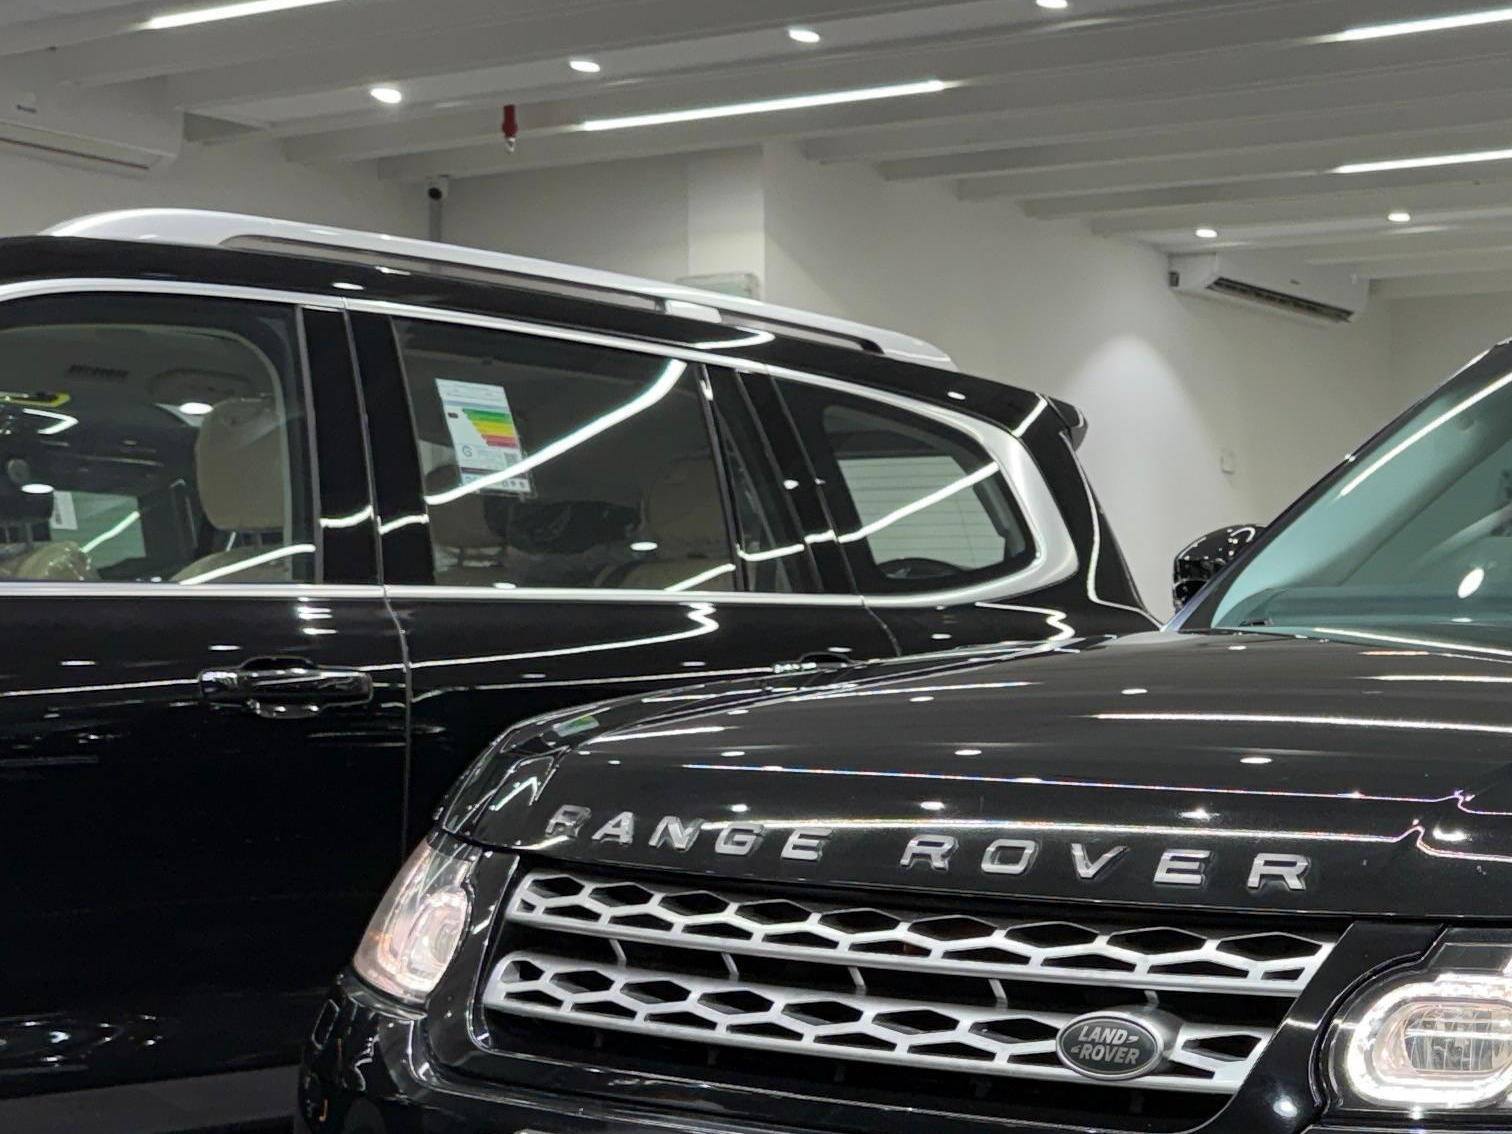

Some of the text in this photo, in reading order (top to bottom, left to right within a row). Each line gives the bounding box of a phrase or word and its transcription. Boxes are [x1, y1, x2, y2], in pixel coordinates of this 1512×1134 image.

[545, 804, 1312, 892] RANGE ROVER
[1078, 1025, 1130, 1045] LAND
[1079, 1043, 1140, 1065] ROVER
